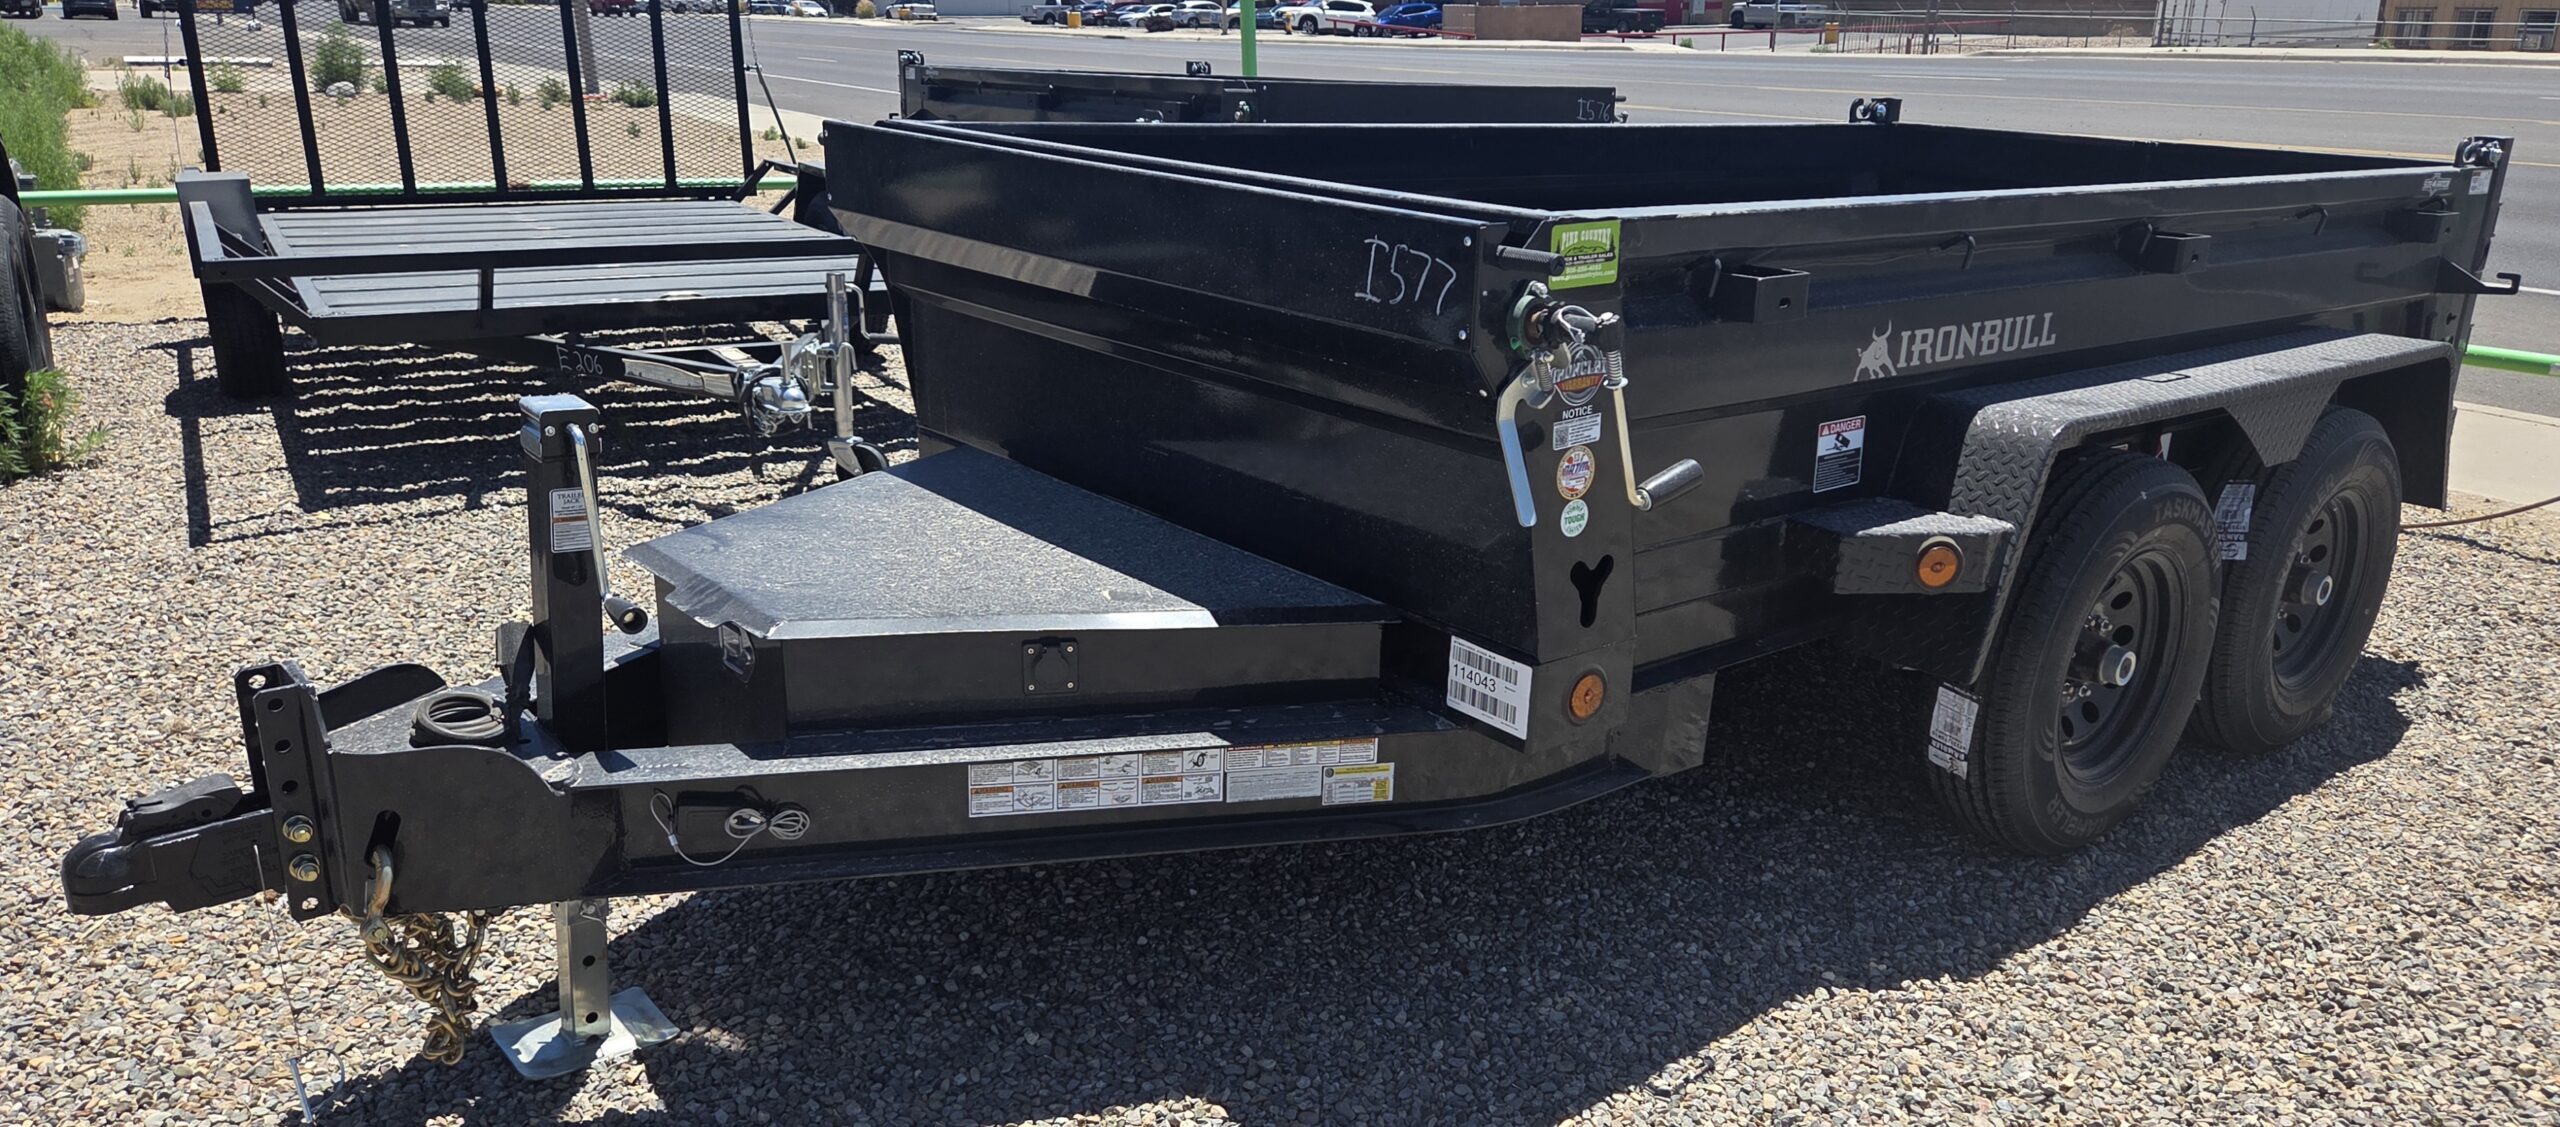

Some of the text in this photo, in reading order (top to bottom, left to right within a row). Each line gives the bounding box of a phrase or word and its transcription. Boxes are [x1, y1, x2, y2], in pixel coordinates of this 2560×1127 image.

[1576, 97, 1611, 122] I576
[1354, 233, 1457, 316] I577
[1896, 311, 2056, 368] IRONBULL
[556, 345, 603, 375] E206
[1562, 405, 1593, 420] NOTICE
[1830, 419, 1862, 434] DANGER
[1453, 663, 1497, 693] 114043
